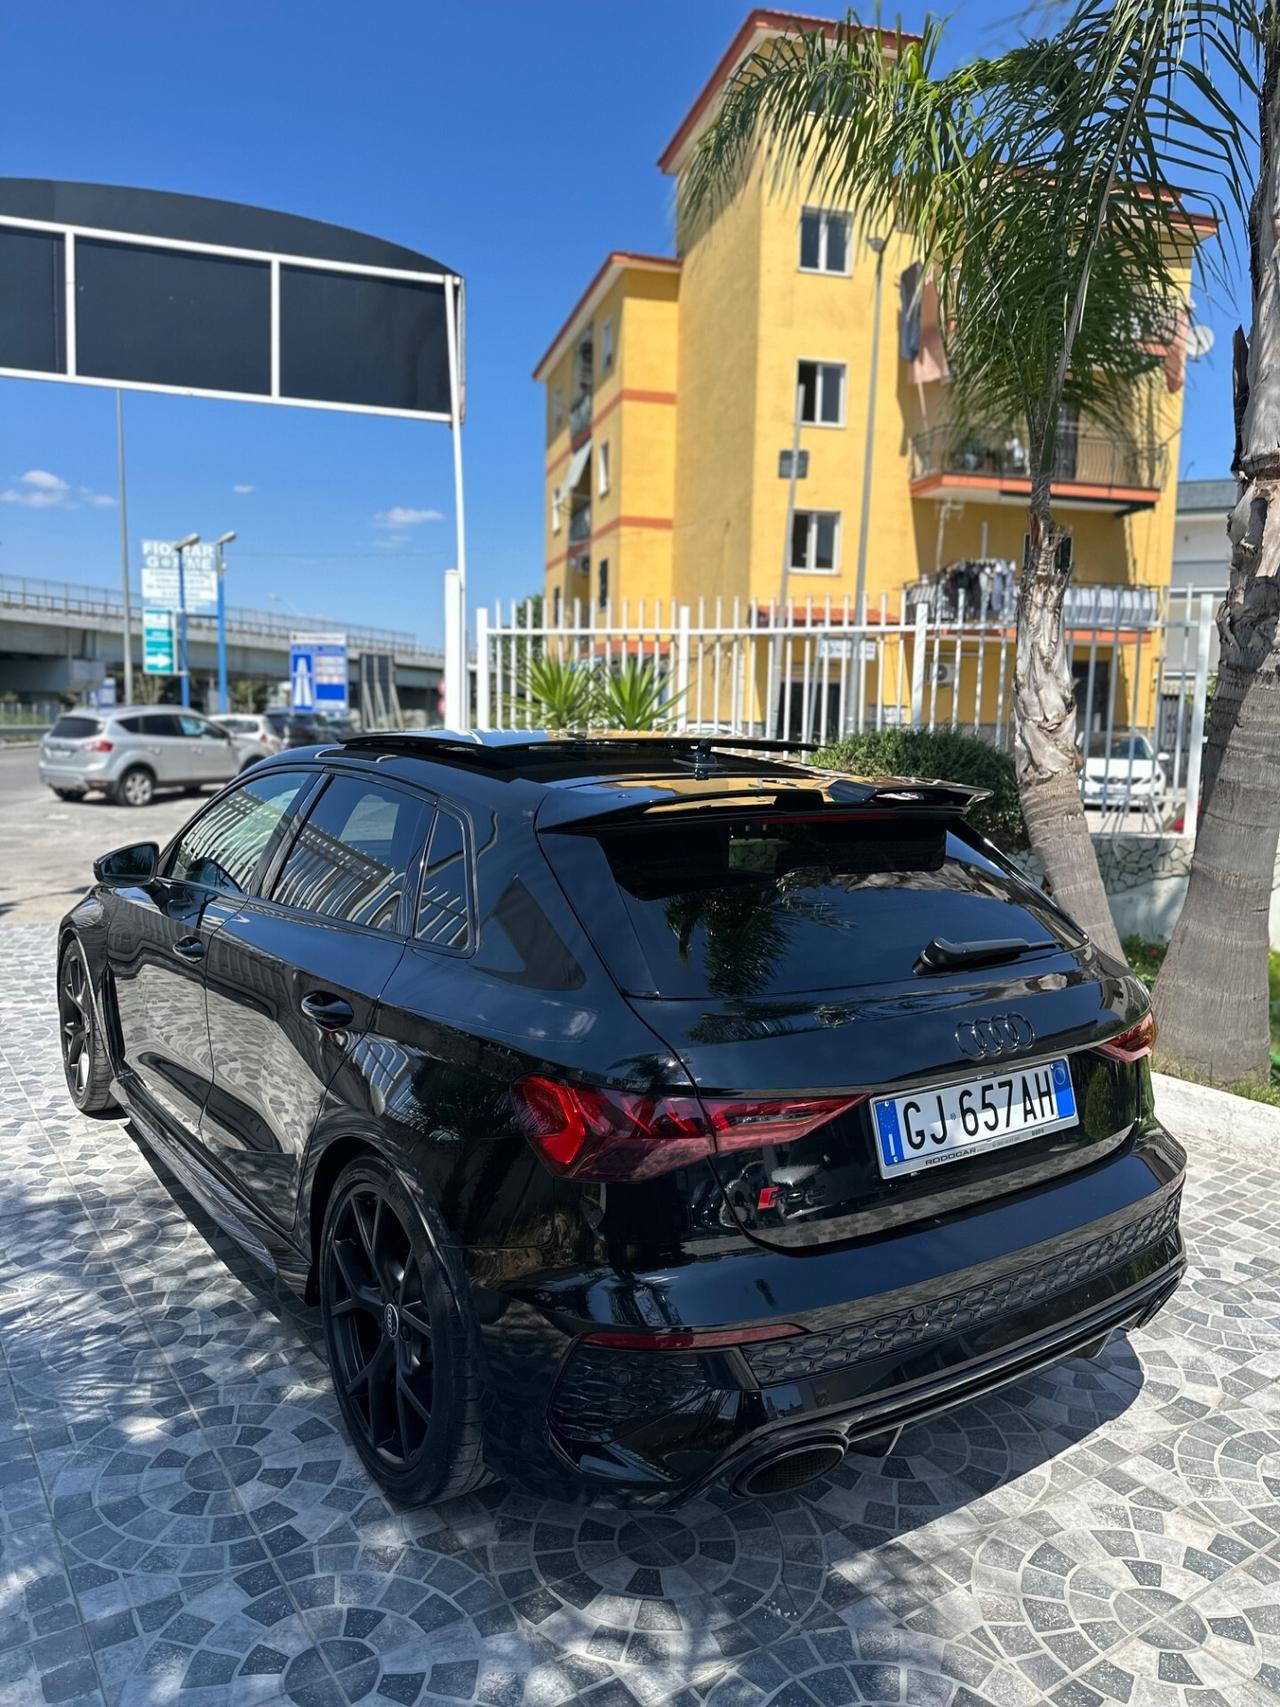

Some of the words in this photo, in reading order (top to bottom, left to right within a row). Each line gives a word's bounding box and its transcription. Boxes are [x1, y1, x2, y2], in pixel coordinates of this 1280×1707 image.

[903, 1095, 948, 1150] GJ
[959, 1070, 1055, 1136] 657AH
[925, 1147, 977, 1166] RODOCAR
